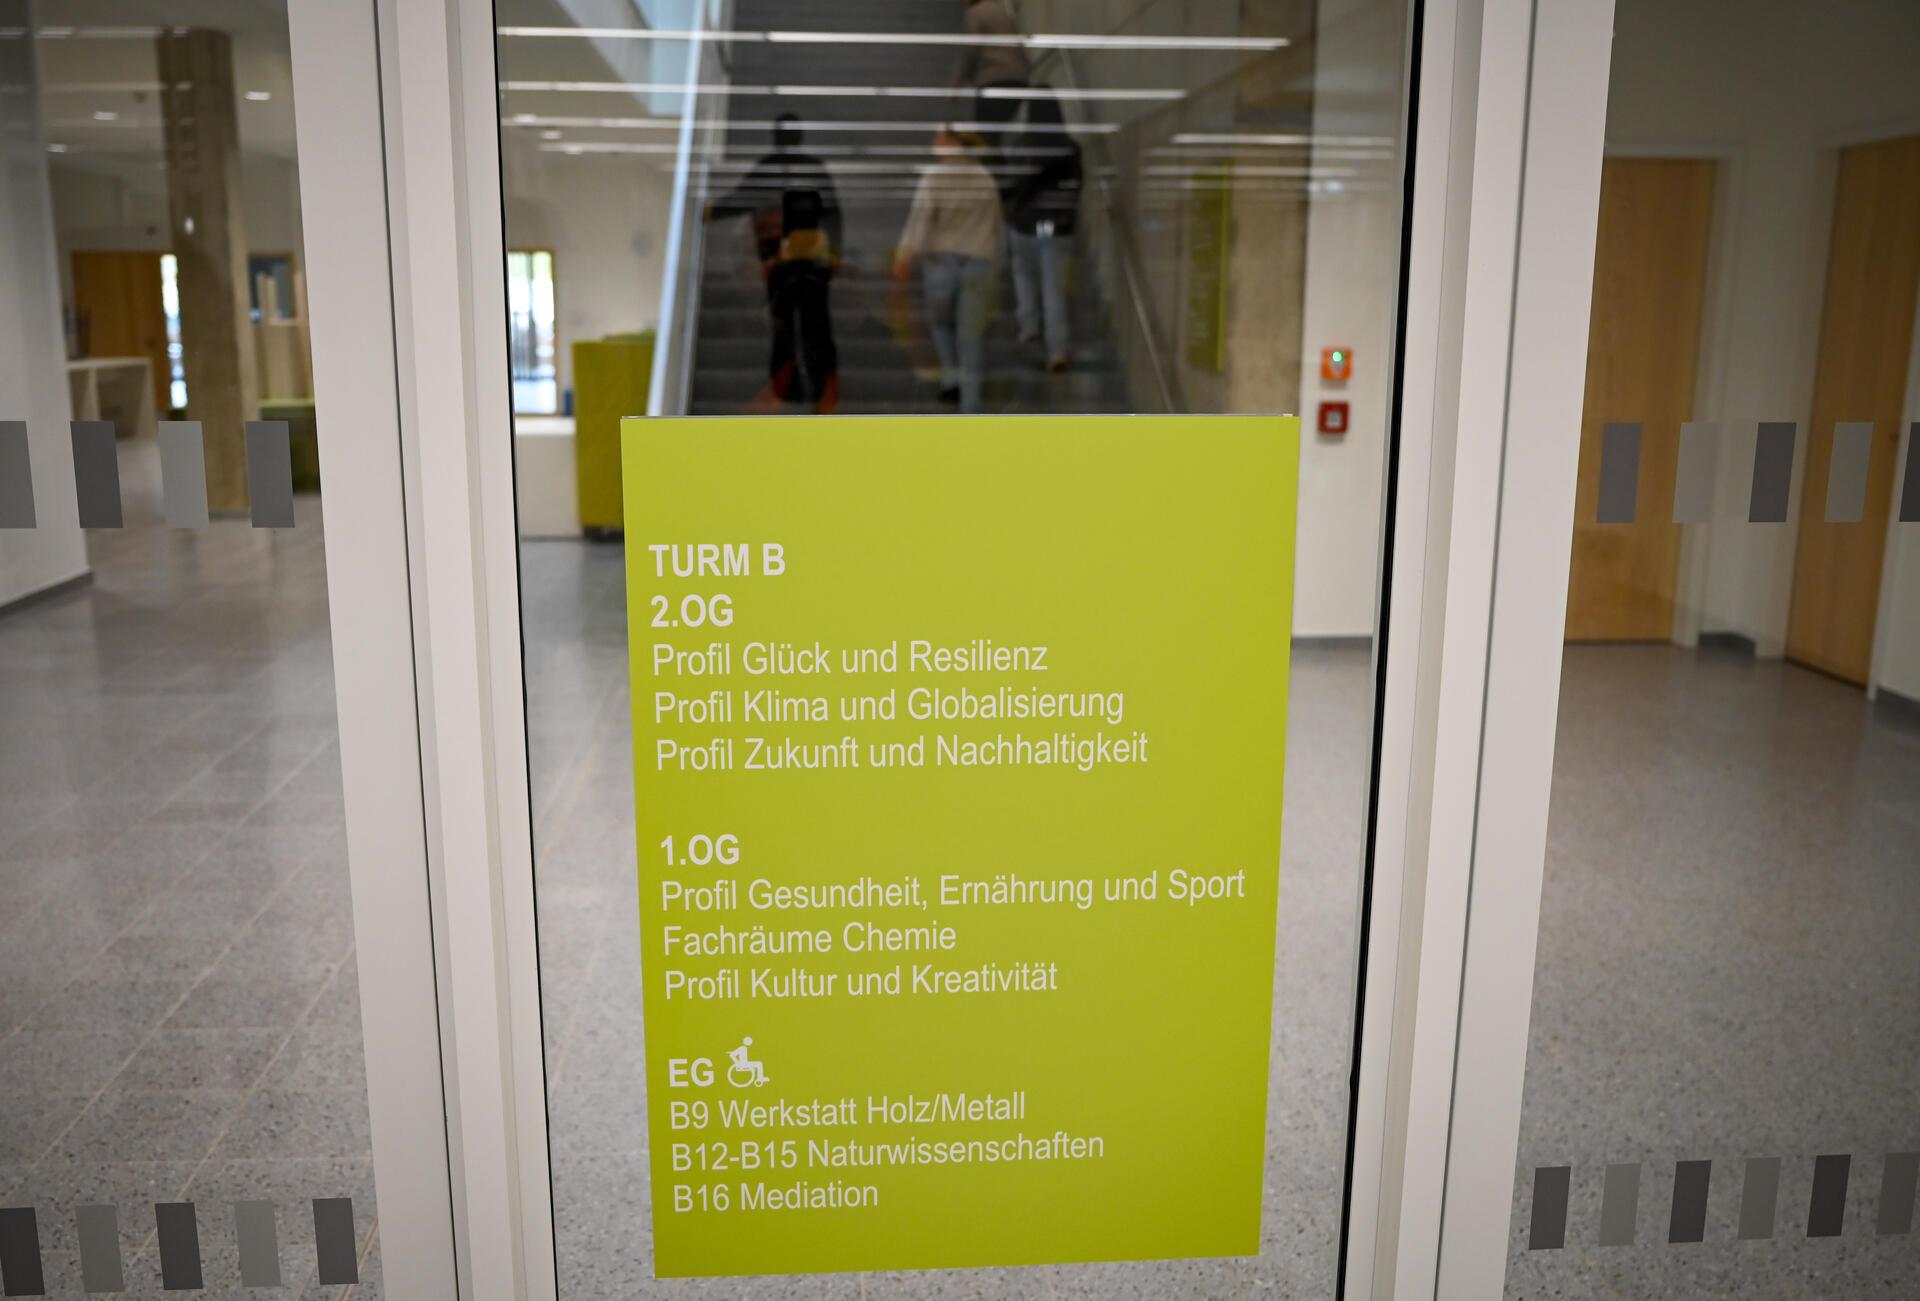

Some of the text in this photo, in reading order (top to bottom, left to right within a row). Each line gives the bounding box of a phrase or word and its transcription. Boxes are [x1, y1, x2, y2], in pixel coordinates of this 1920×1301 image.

[648, 543, 786, 577] TURM B
[651, 593, 734, 628] 2.OG
[653, 639, 1048, 676] Profil Glück und Resilienz
[655, 686, 1124, 725] Profil Klima und Globalisierung
[656, 732, 1148, 773] Profil Zukunft und Nachhaltigkeit
[660, 833, 740, 866] 1.OG
[662, 869, 1246, 911] Profil Gesundheit, Ernährung und Sport
[664, 921, 957, 956] Fachräume Chemie
[665, 962, 1057, 1000] Profil Kultur und Kreativität
[668, 1057, 715, 1088] EG
[670, 1091, 1025, 1129] B9 Werkstatt Holz/Metall
[672, 1131, 1104, 1171] B12-B15 Naturwissenschaften
[674, 1182, 878, 1212] B16 Mediation
